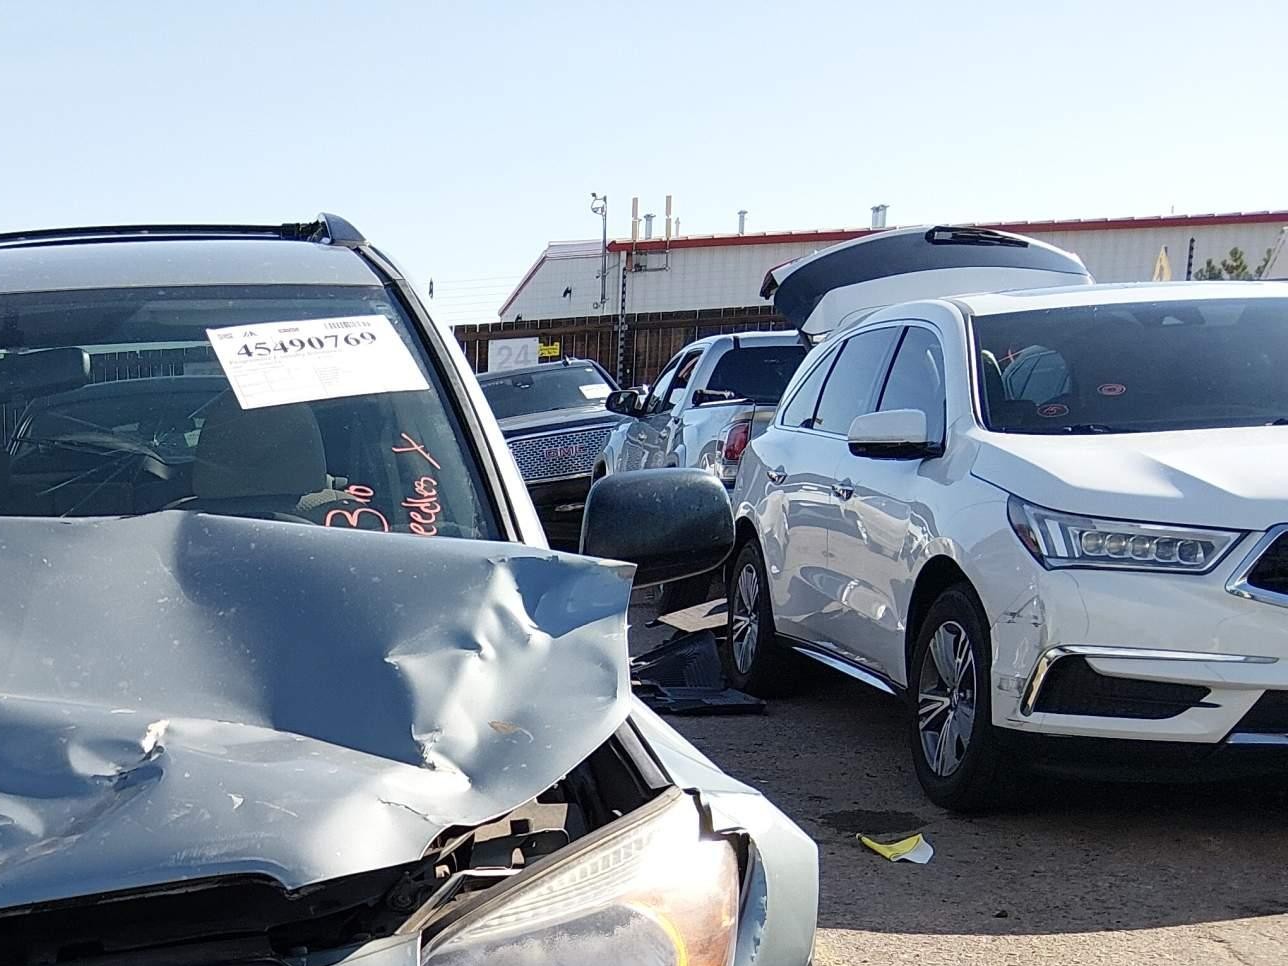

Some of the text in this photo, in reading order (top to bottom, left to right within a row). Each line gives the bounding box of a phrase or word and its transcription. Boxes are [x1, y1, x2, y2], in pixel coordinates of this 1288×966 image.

[237, 331, 377, 358] 45490769
[498, 344, 530, 368] 24
[544, 444, 585, 460] GMC
[401, 476, 441, 536] eedles
